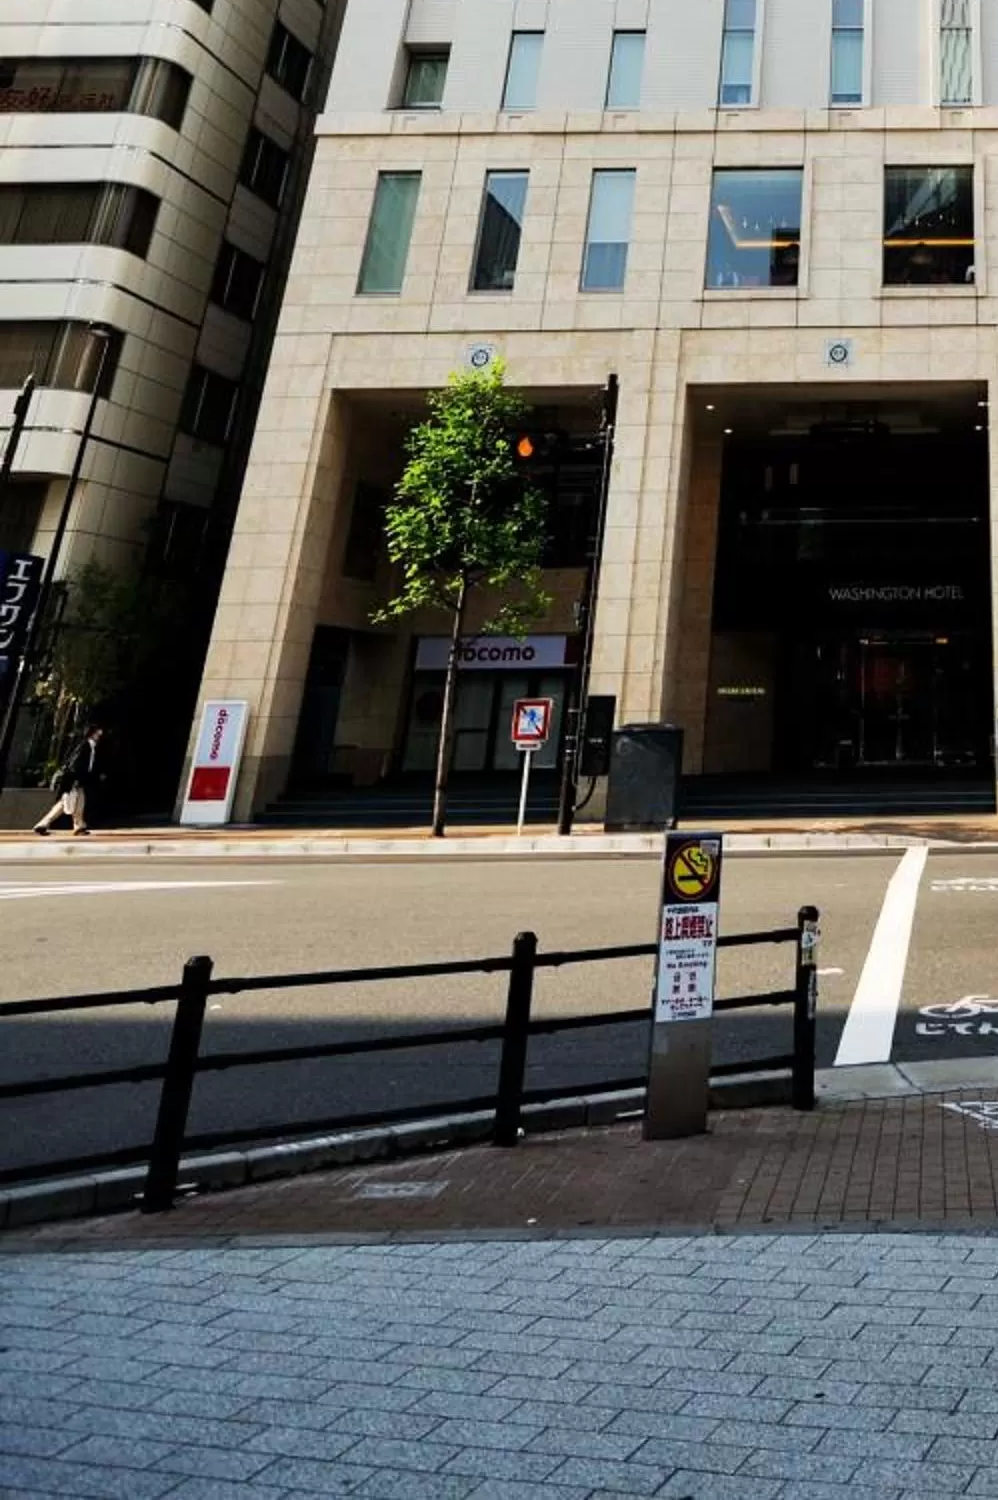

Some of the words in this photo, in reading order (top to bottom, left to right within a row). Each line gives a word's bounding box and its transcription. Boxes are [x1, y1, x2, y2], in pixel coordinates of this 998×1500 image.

[828, 586, 922, 601] WASHINGTON
[924, 584, 965, 601] HOTEL
[209, 707, 229, 760] docomo
